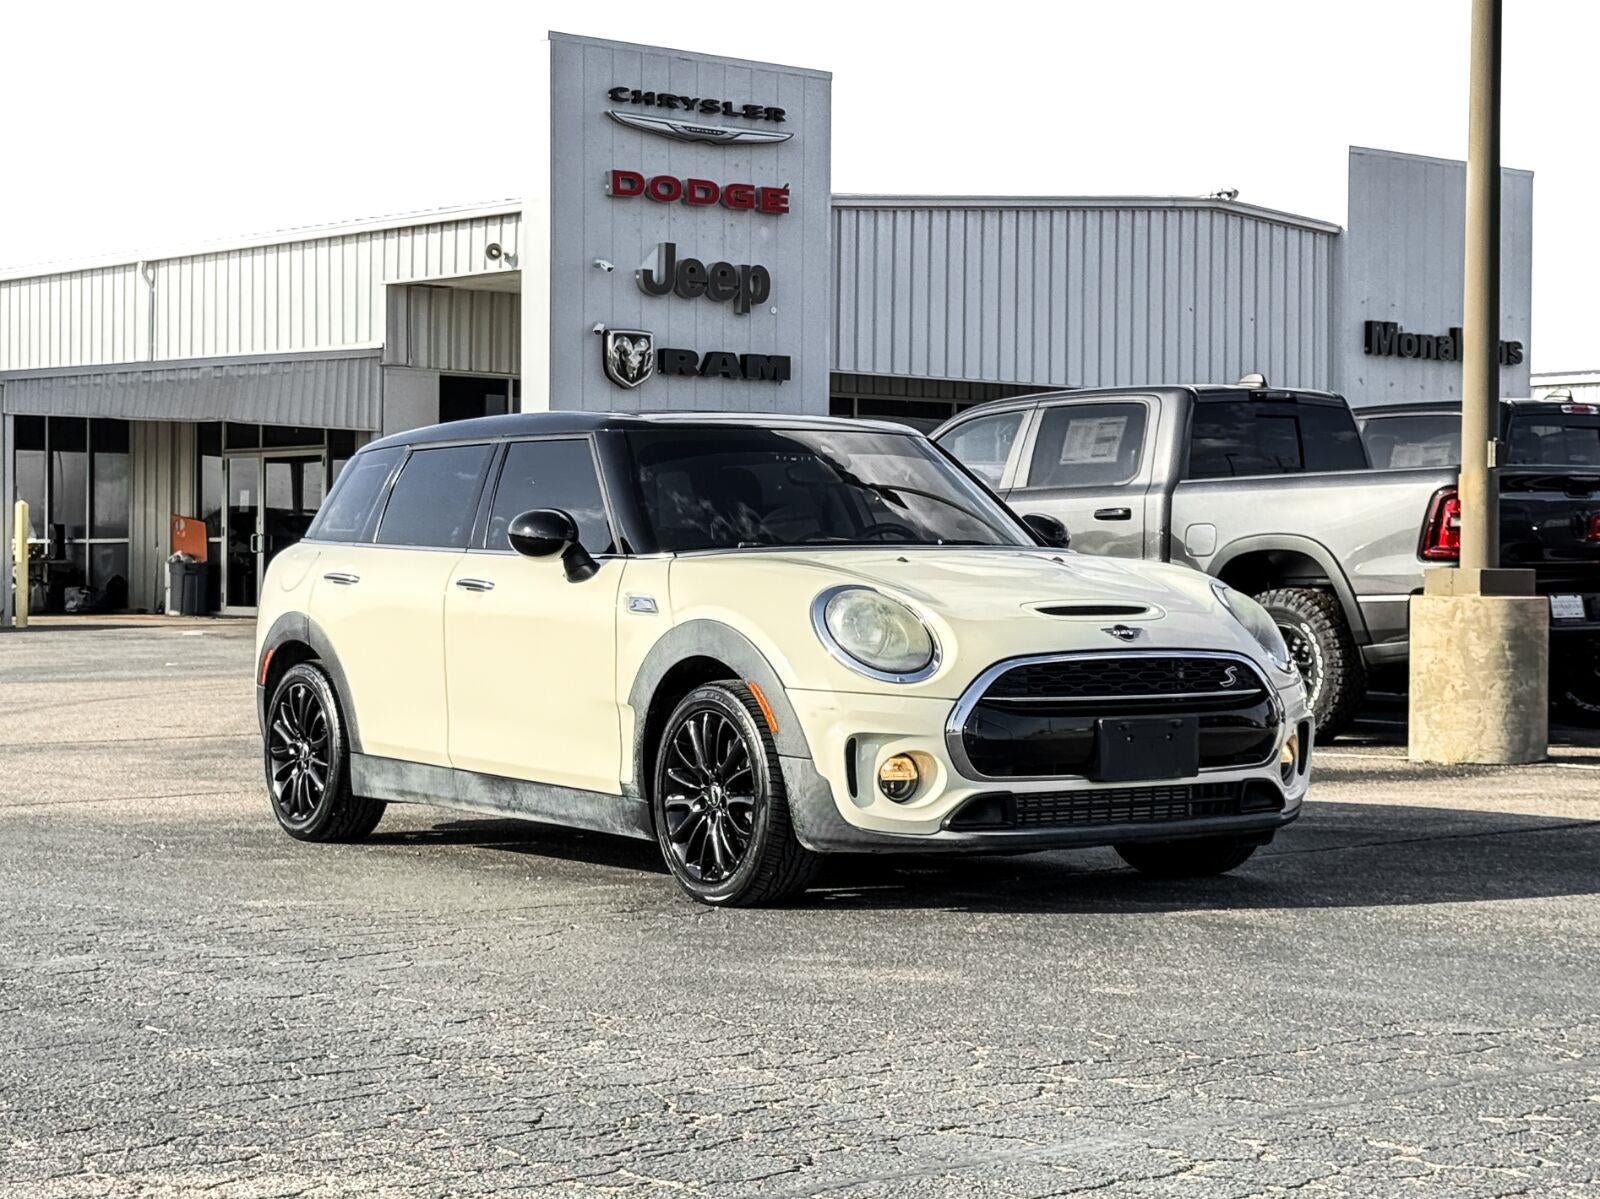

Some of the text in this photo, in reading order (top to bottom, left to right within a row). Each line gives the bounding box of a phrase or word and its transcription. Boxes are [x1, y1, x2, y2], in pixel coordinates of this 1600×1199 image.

[607, 86, 787, 122] CHRYSLER
[606, 169, 790, 214] DODGE
[636, 242, 771, 315] Jeep
[657, 348, 791, 382] RAM
